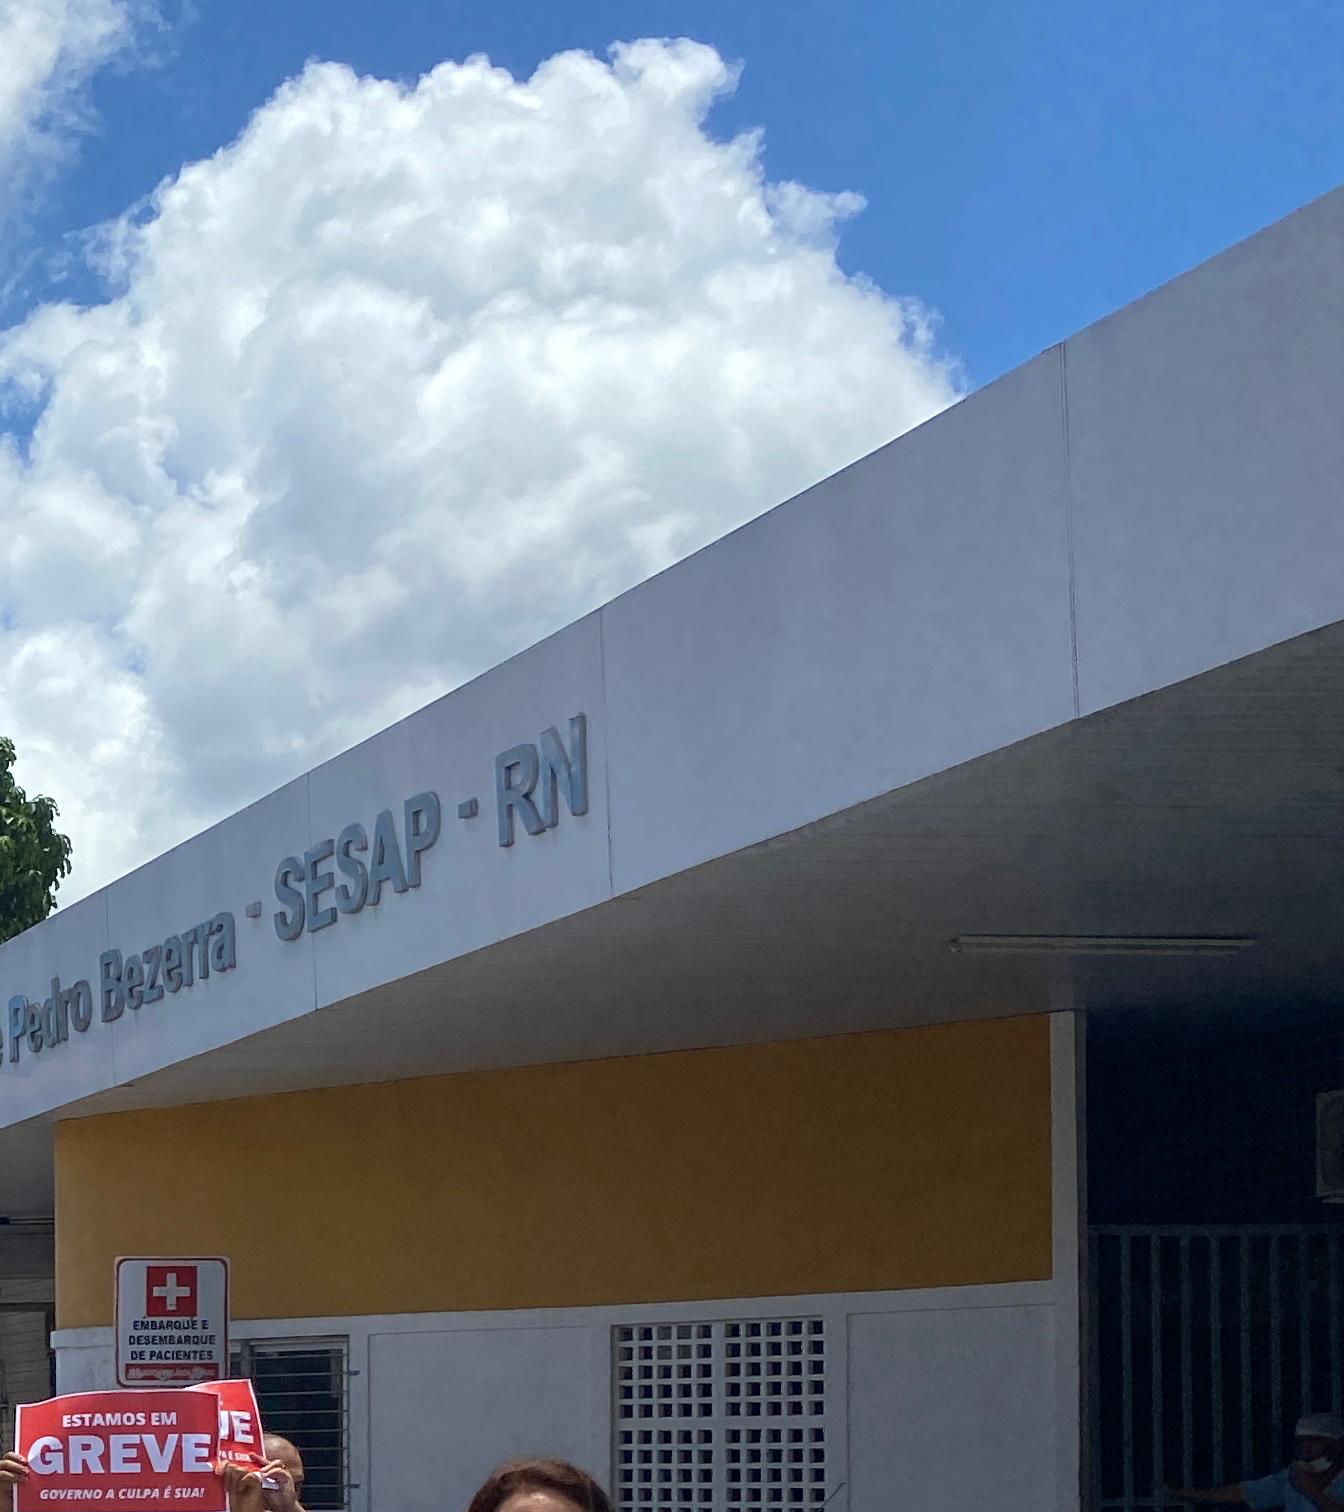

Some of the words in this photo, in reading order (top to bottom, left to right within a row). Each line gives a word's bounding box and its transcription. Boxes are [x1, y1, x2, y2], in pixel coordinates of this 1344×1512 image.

[9, 976, 93, 1064] Pedro
[99, 911, 237, 1023] Bezerra
[273, 791, 443, 942] SESAP
[496, 713, 591, 848] RN
[133, 1319, 198, 1331] EMBARQUE
[201, 1319, 209, 1330] E
[128, 1335, 216, 1346] DESEMBARQUE
[130, 1350, 146, 1361] DE
[149, 1350, 214, 1361] PACIENTES
[62, 1412, 146, 1428] ESTAMOS
[150, 1412, 177, 1426] EM
[27, 1433, 214, 1475] GREVE
[39, 1488, 102, 1500] GOVERNO
[105, 1488, 115, 1499] A
[118, 1488, 160, 1499] CULPA
[174, 1487, 205, 1499] SUA!
